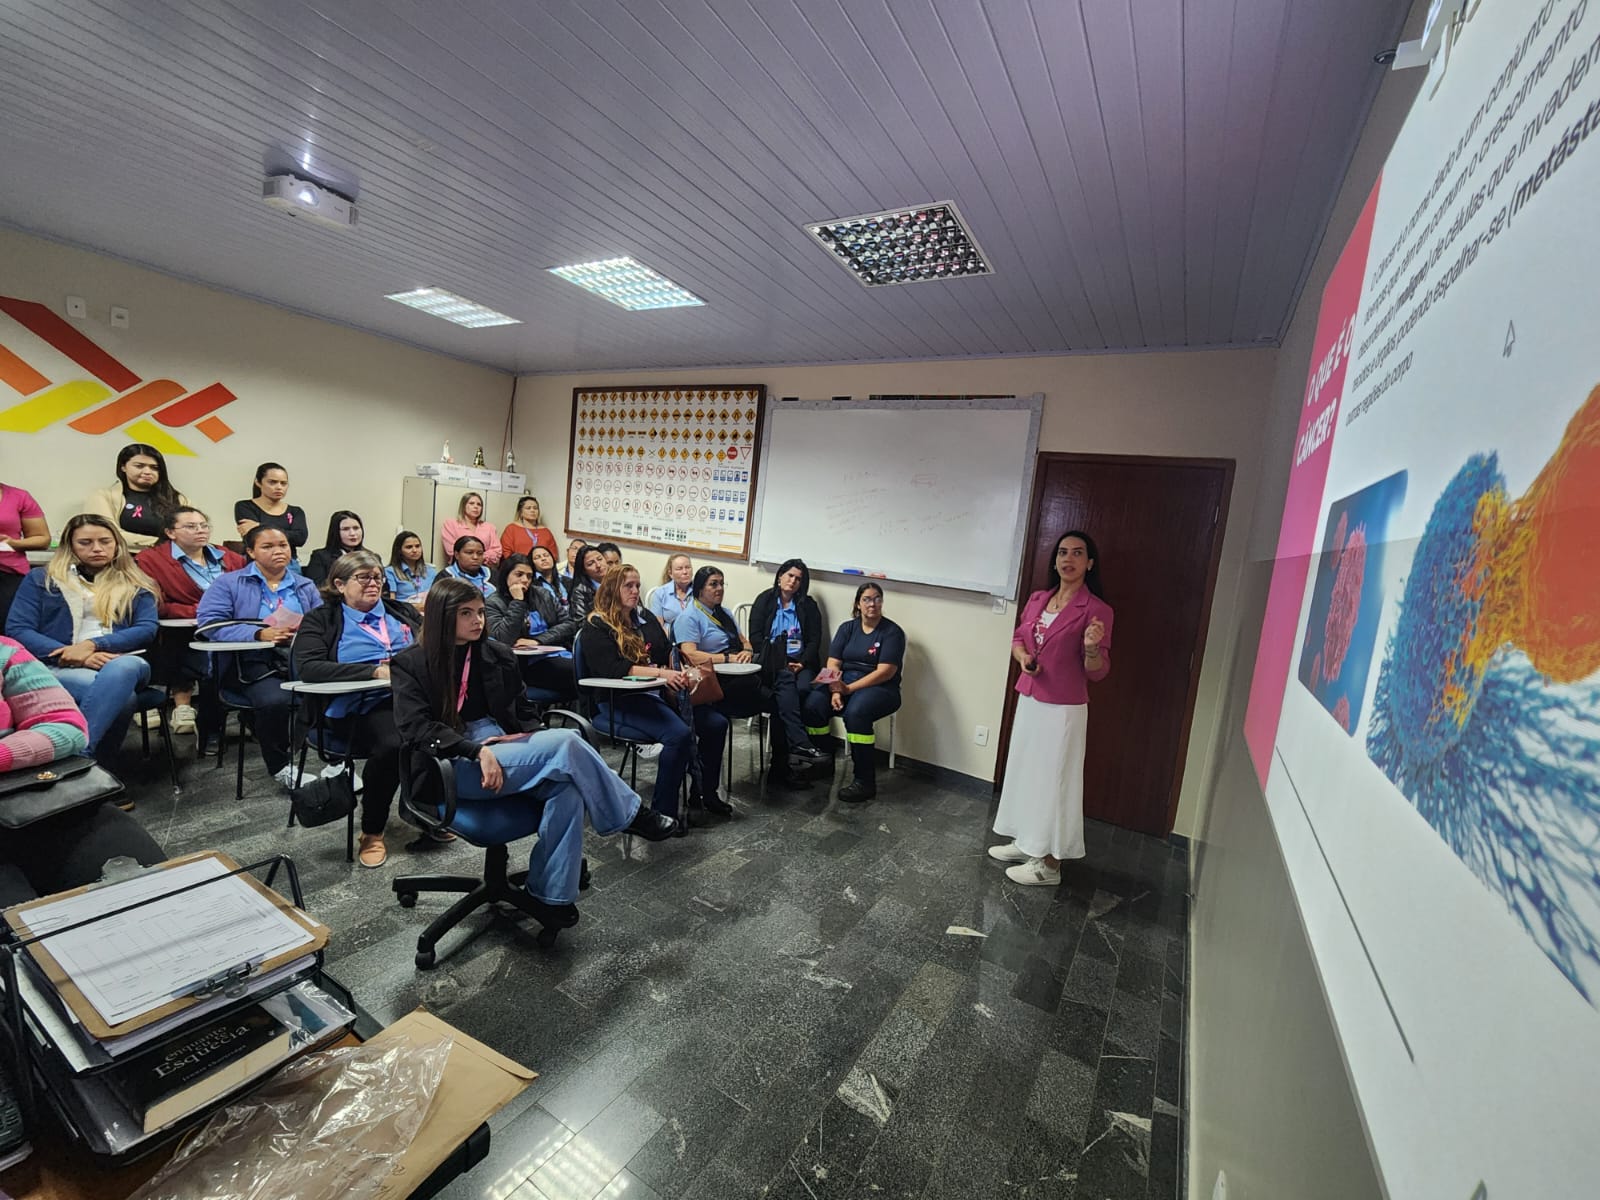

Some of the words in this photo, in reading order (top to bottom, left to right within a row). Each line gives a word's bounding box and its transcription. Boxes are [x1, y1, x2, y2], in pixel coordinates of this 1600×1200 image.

[1407, 189, 1431, 235] nome
[1432, 151, 1455, 199] dado
[1456, 137, 1464, 161] a
[1464, 104, 1485, 148] um
[1485, 0, 1554, 114] conjunto
[1430, 166, 1468, 234] comum
[1469, 152, 1478, 178] o
[1479, 0, 1587, 162] crescimento
[1431, 237, 1444, 268] de
[1445, 184, 1486, 250] células
[1487, 144, 1517, 200] que
[1396, 289, 1433, 350] podendo
[1433, 206, 1506, 303] espalhar-se
[1307, 374, 1315, 407] O
[1314, 342, 1336, 403] QUE
[1343, 313, 1356, 358] O
[152, 1025, 250, 1078] Esquecia
[165, 1026, 227, 1061] enquanto
